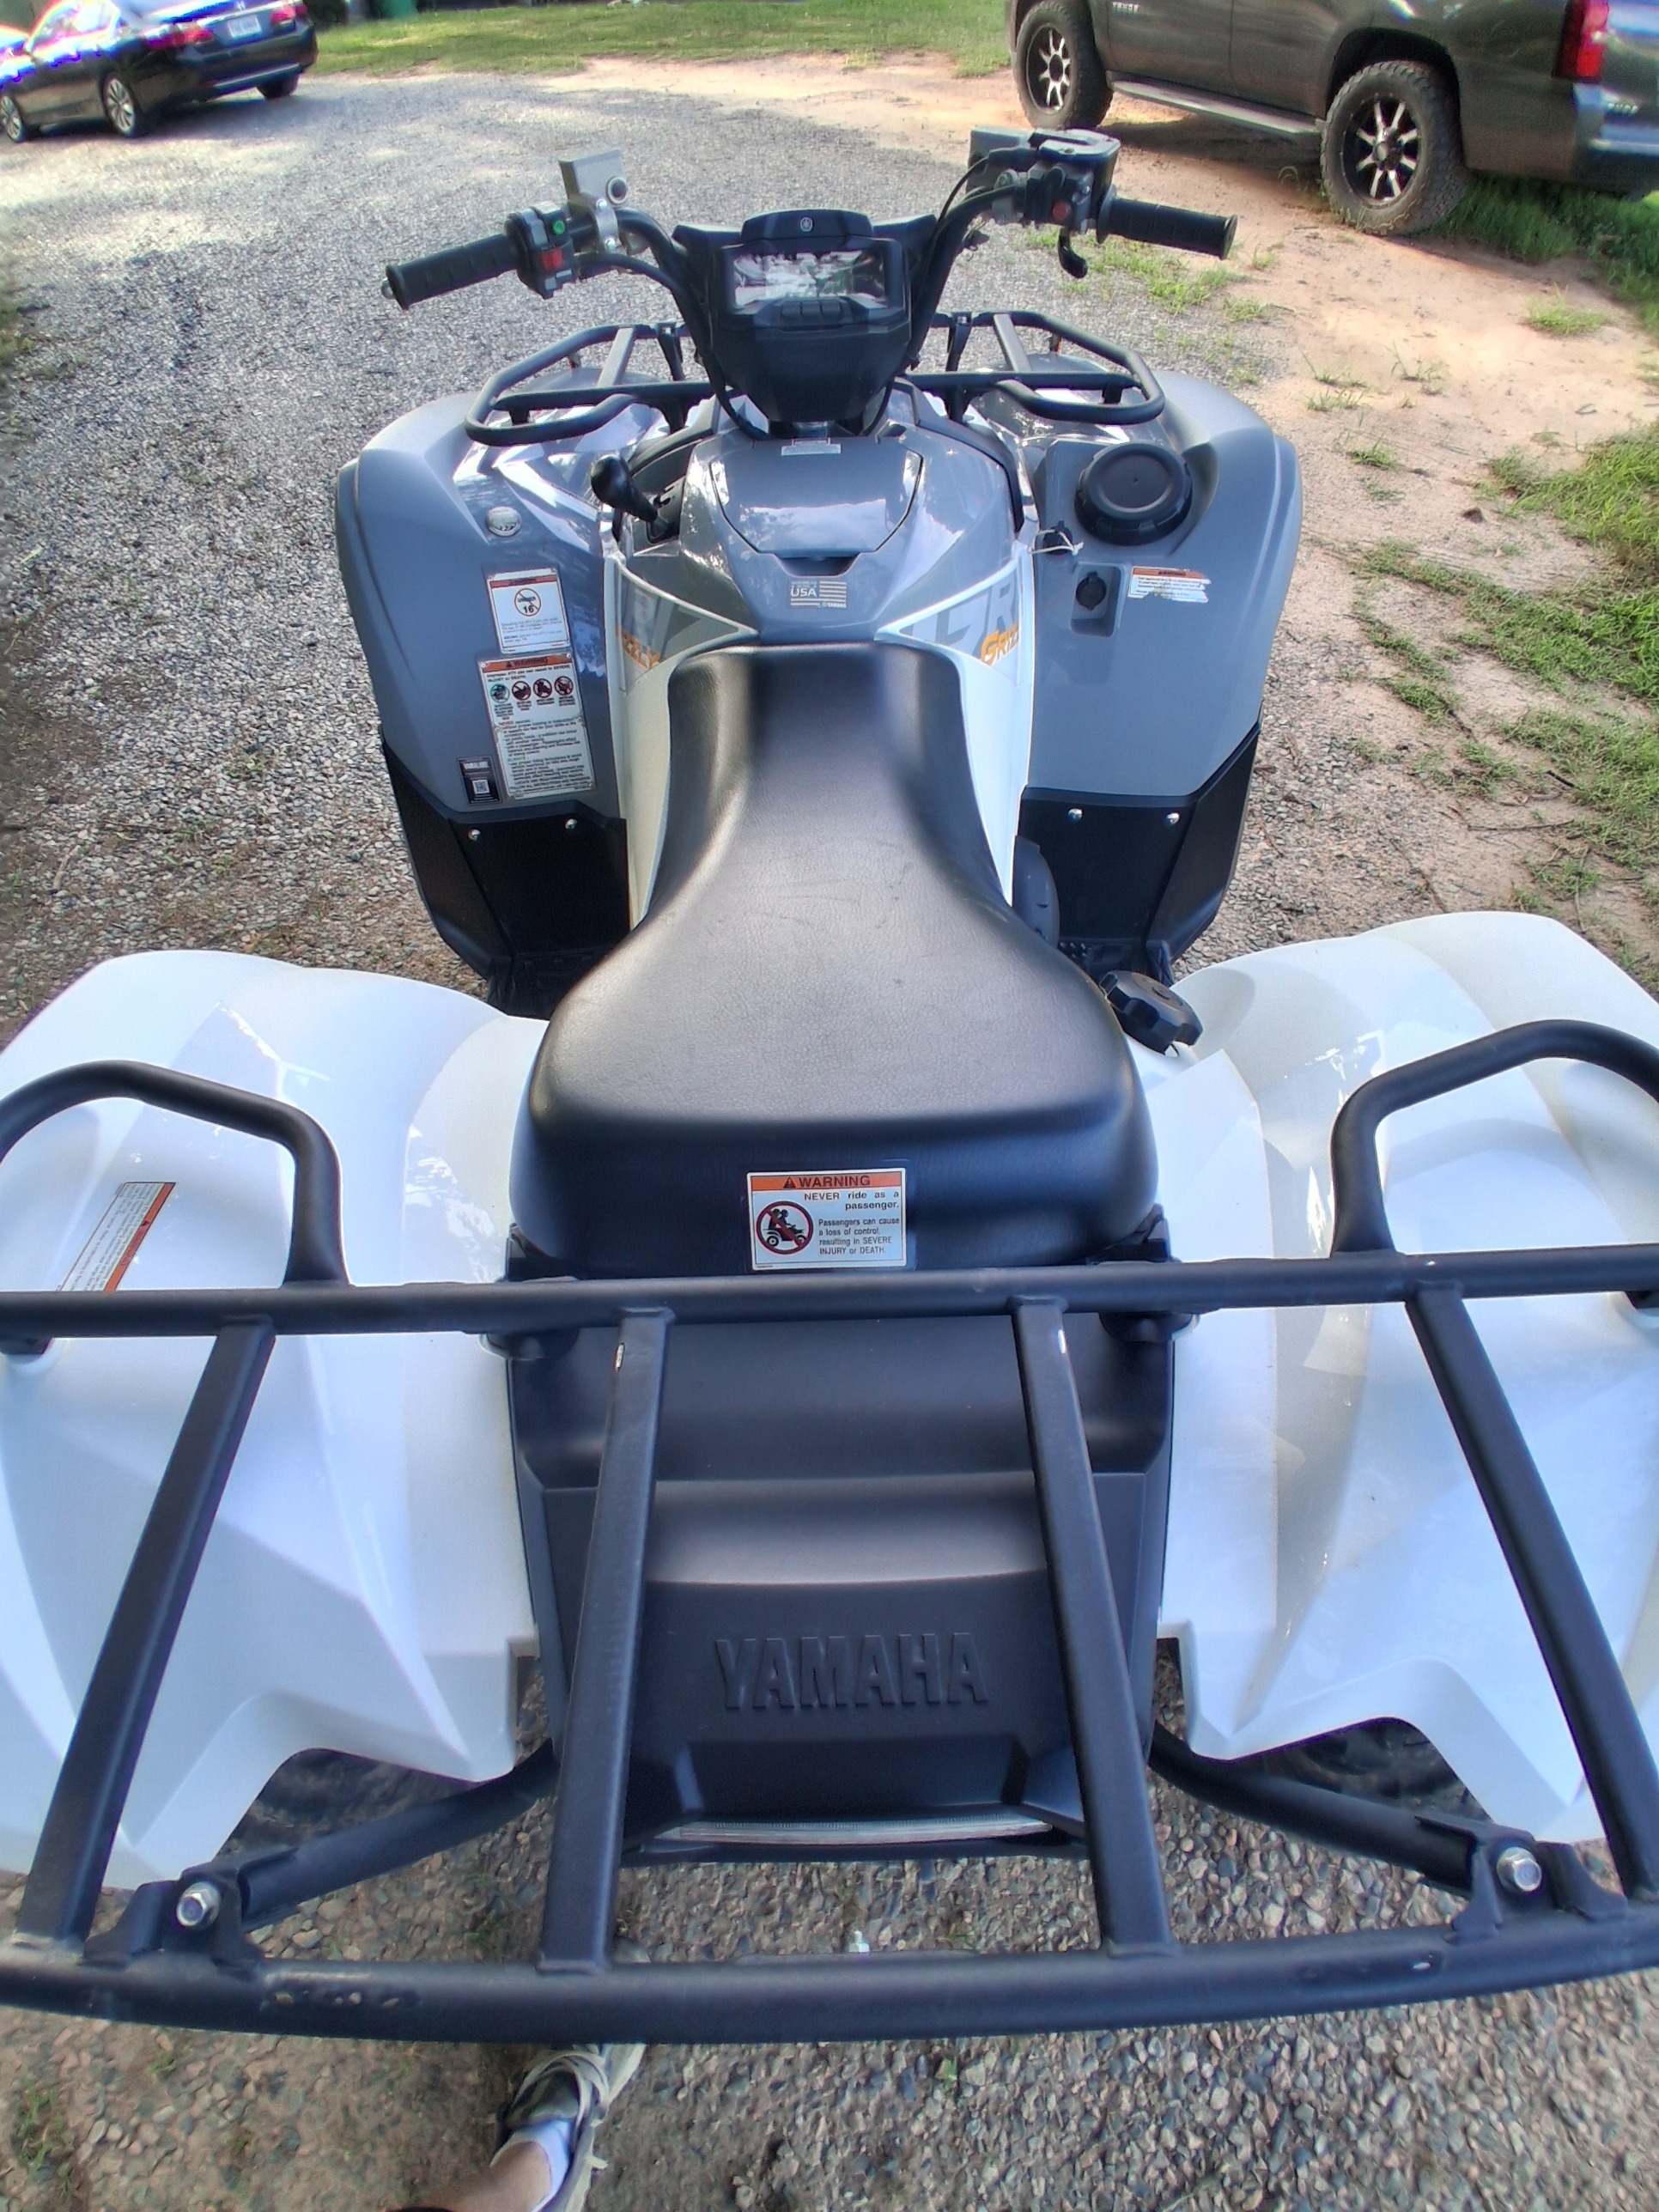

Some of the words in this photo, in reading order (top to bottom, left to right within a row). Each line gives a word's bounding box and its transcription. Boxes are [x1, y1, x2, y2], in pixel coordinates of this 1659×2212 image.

[790, 587, 817, 597] USA
[523, 605, 534, 613] 16
[799, 1175, 871, 1188] WARNING
[804, 1192, 840, 1200] NEVER
[848, 1190, 867, 1200] ride
[845, 1202, 899, 1212] passenger.
[818, 1218, 860, 1227] Passengers
[844, 1227, 851, 1236] of
[819, 1237, 851, 1247] resulting
[863, 1236, 893, 1244] SEVERE
[714, 1632, 988, 1709] YAMAHA
